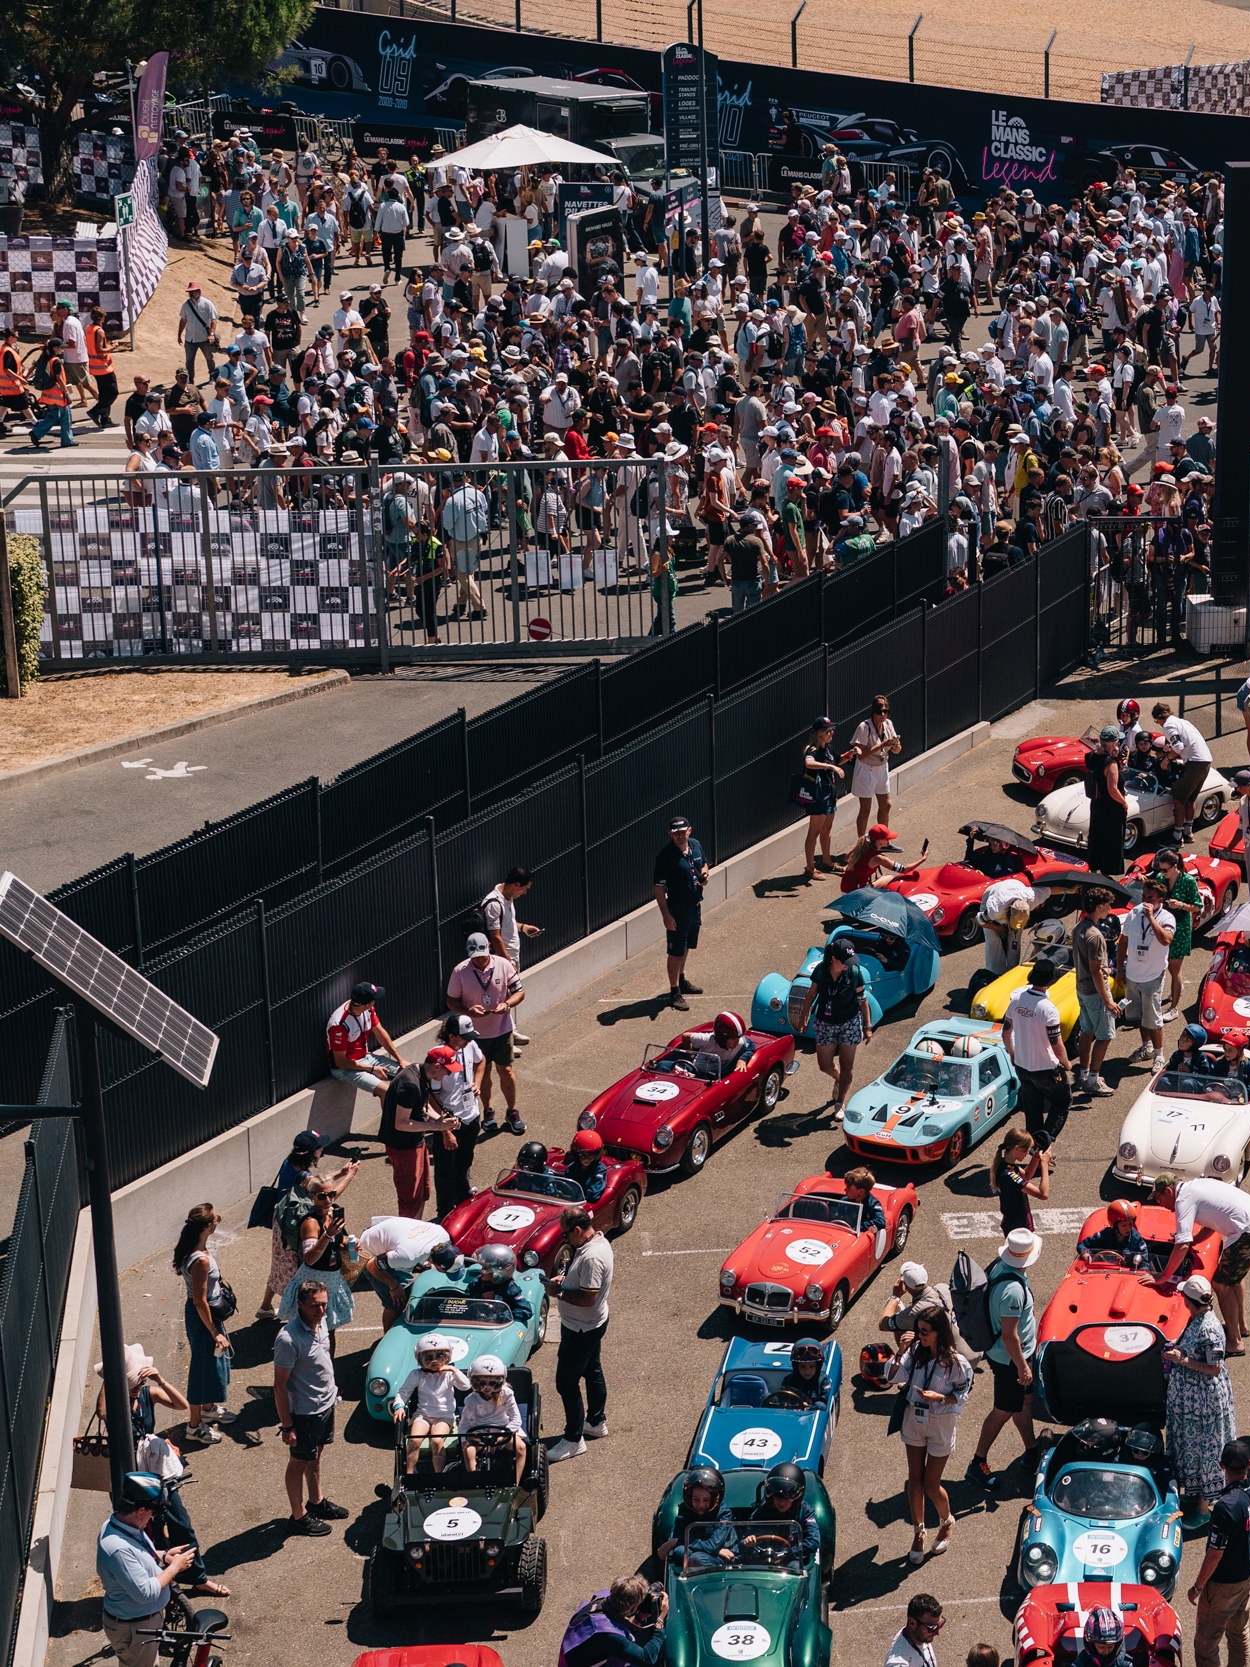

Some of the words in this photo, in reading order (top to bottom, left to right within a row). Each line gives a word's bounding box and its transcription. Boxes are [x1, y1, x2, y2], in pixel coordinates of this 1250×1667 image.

[378, 30, 417, 60] Grid
[798, 112, 830, 121] PEUGEOT
[991, 110, 1007, 126] LE
[991, 126, 1030, 144] MANS
[386, 137, 405, 145] CLASSIC
[991, 142, 1047, 162] CLASSIC
[982, 146, 1057, 190] Legend
[781, 169, 788, 177] LE
[787, 170, 804, 179] MANS
[564, 200, 609, 212] NAVETTES
[646, 1086, 668, 1094] 34
[895, 1105, 912, 1115] 9
[986, 1097, 994, 1118] 9
[1166, 1110, 1184, 1118] 17
[503, 1213, 520, 1222] 11
[798, 1245, 821, 1257] 52
[1119, 1331, 1139, 1343] 37
[743, 1437, 769, 1448] 43
[446, 1518, 460, 1529] 5
[1090, 1544, 1112, 1555] 16
[727, 1634, 756, 1646] 38
